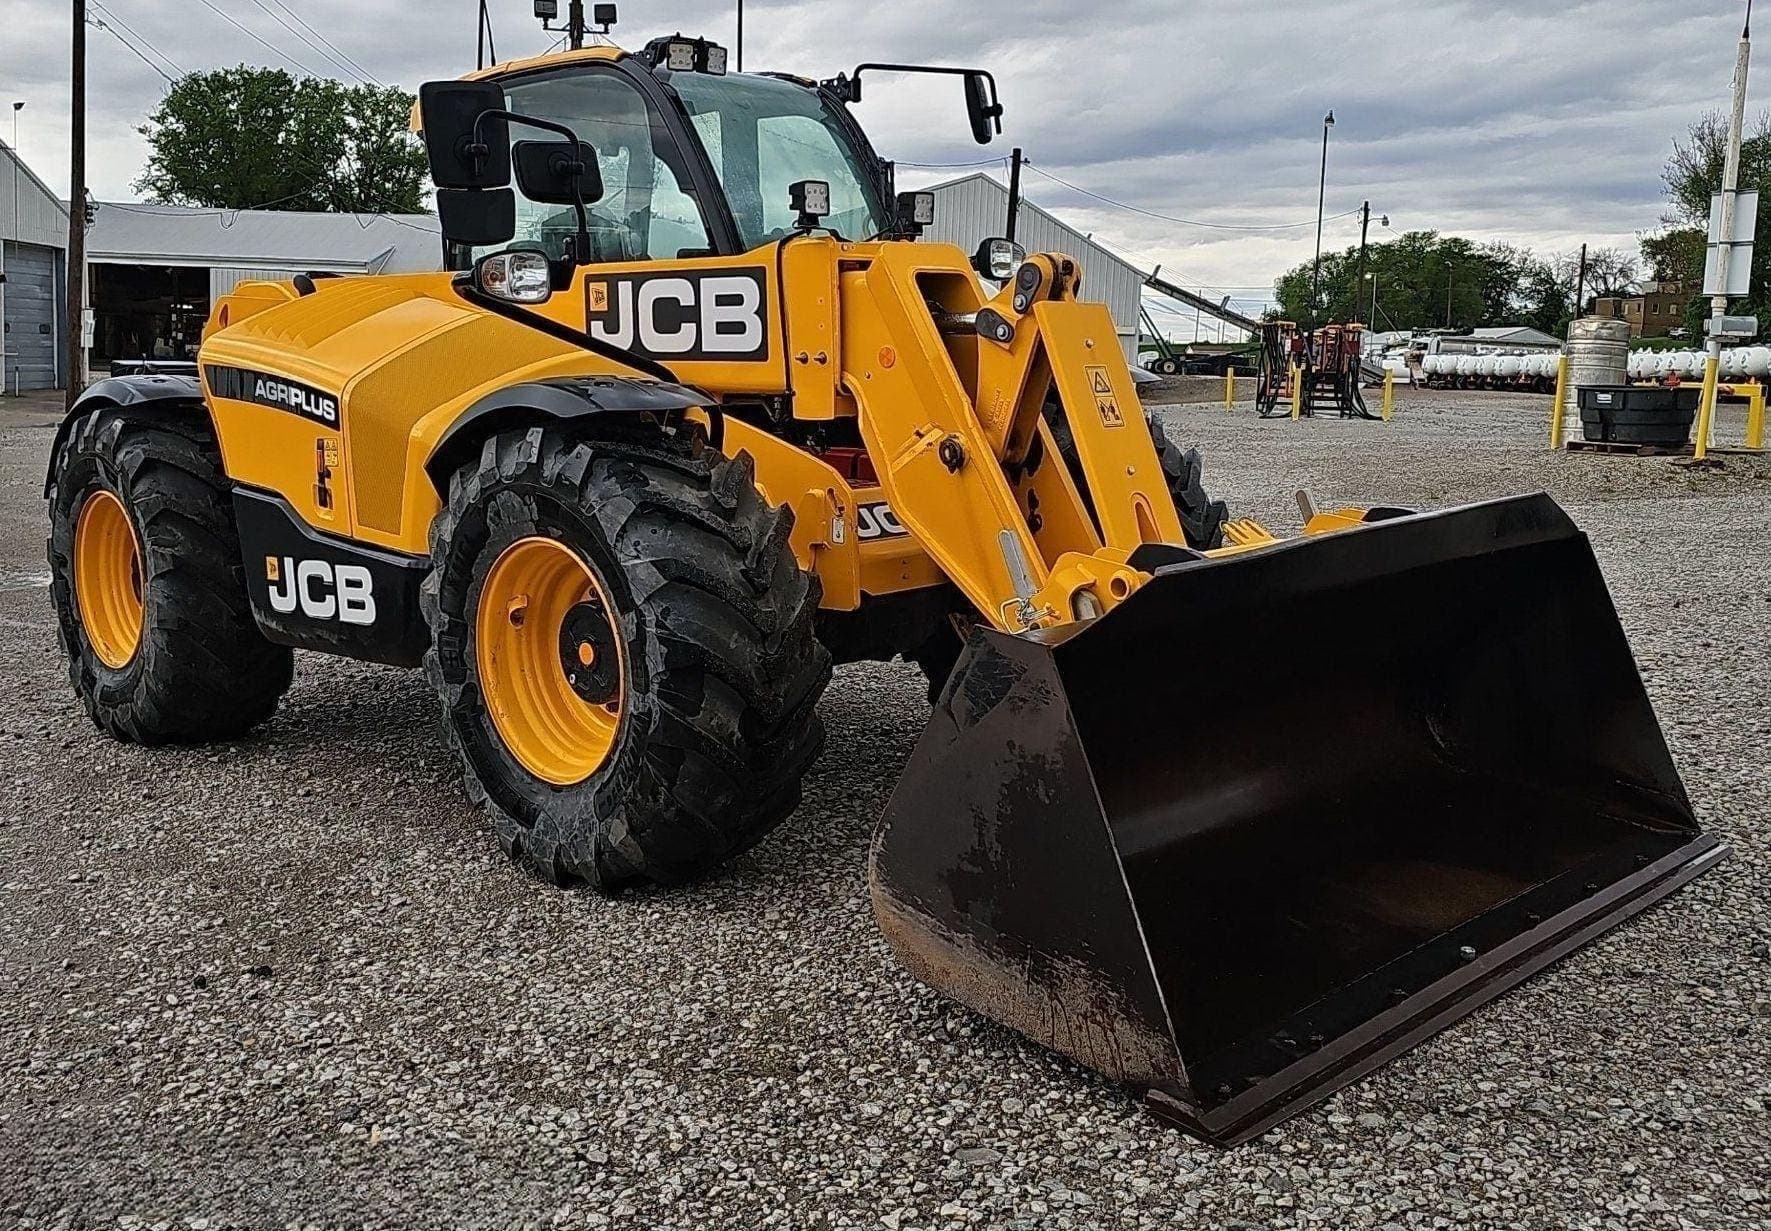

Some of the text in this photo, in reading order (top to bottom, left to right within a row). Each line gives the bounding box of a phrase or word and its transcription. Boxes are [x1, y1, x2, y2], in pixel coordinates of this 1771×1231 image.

[590, 276, 763, 353] JCB
[254, 379, 336, 421] AGRIPLUS
[858, 505, 906, 537] JC
[267, 556, 377, 625] JCB
